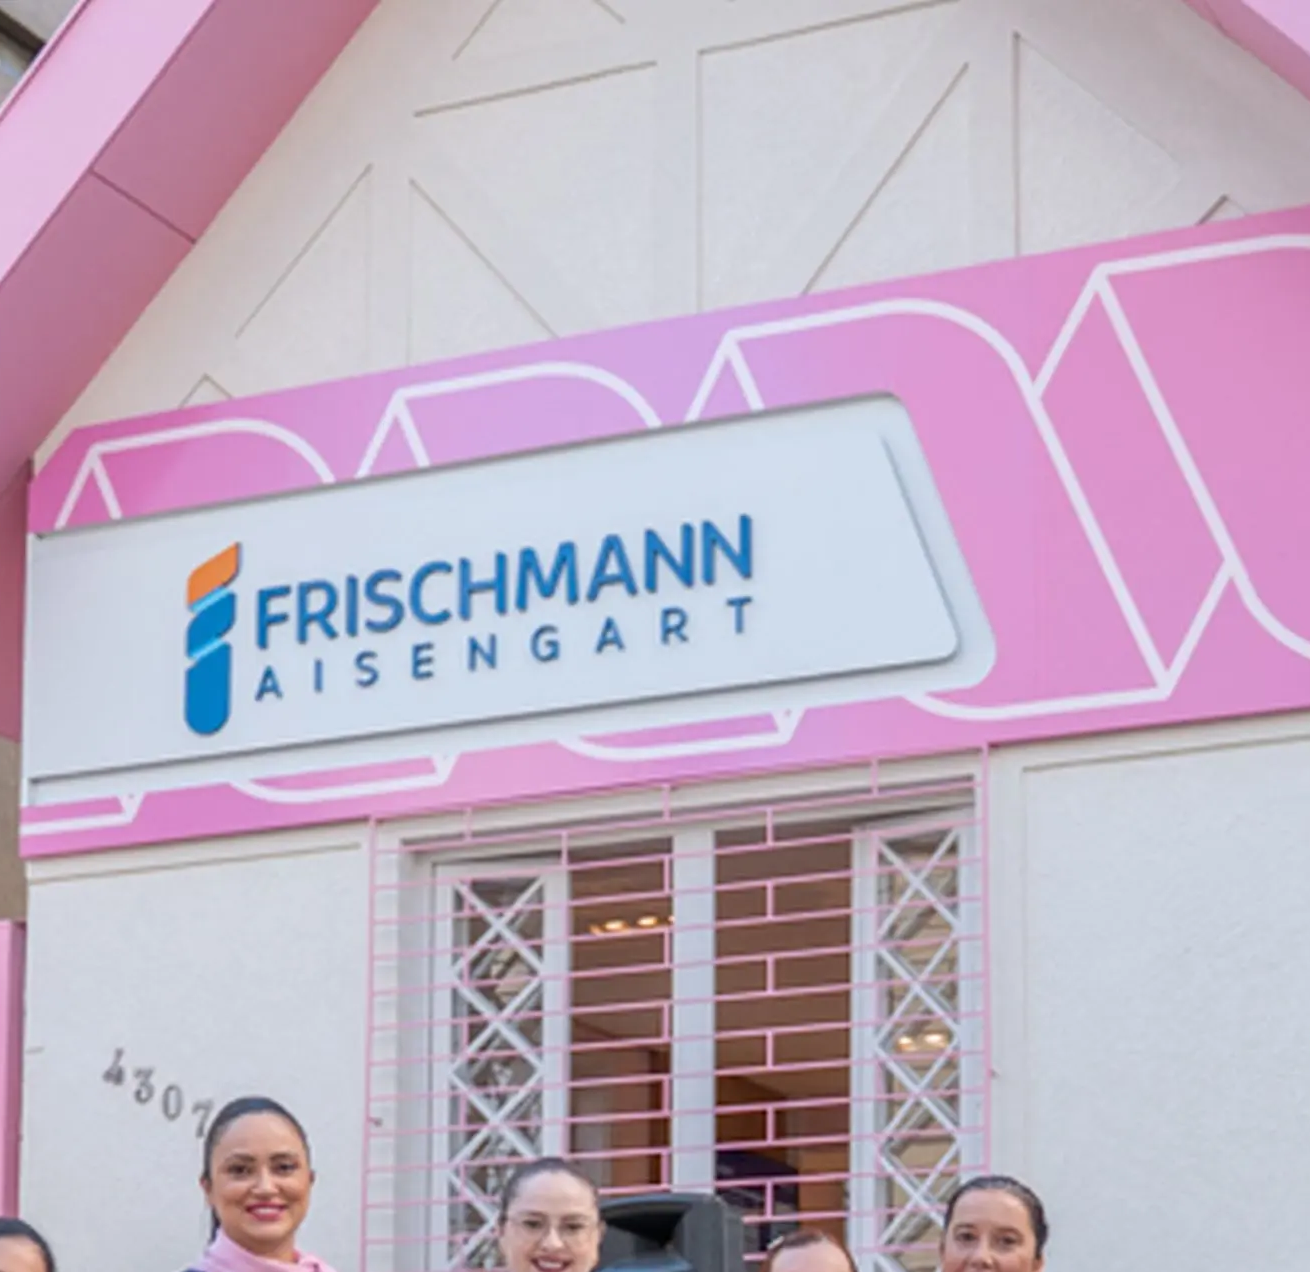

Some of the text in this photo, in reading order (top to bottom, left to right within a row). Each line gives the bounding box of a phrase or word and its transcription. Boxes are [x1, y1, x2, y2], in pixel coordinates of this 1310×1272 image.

[256, 513, 754, 650] FRISCHMANN
[255, 596, 754, 701] AISENGART
[103, 1048, 213, 1139] 4307
